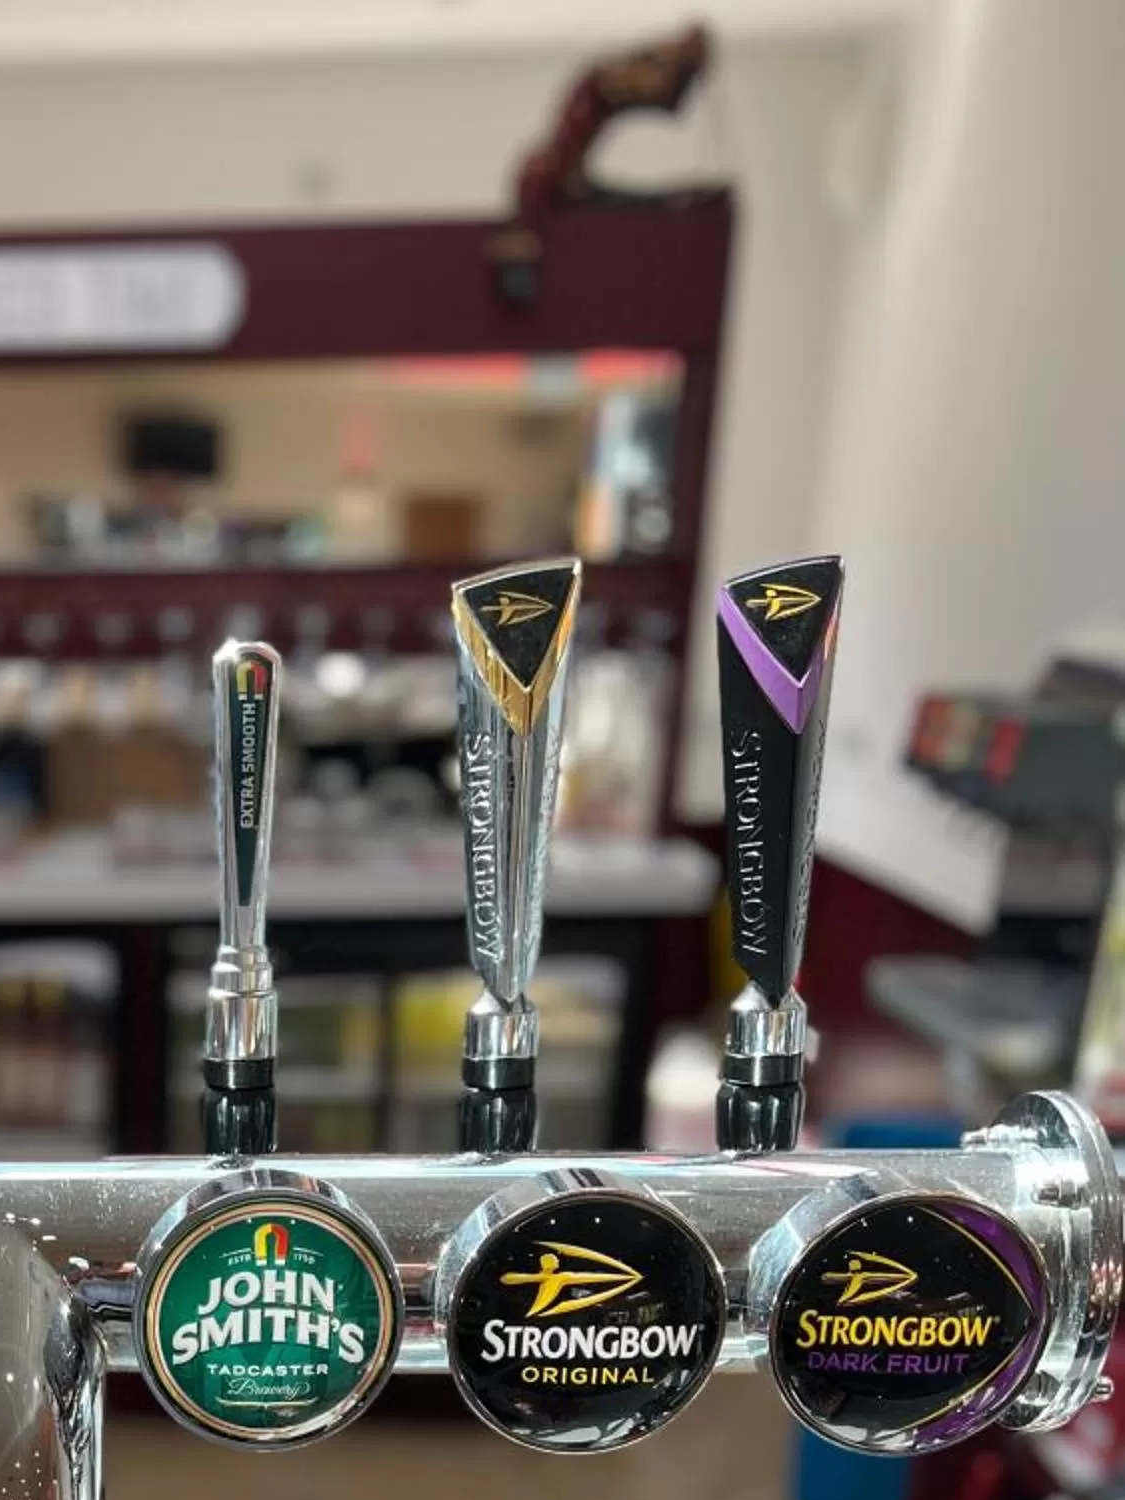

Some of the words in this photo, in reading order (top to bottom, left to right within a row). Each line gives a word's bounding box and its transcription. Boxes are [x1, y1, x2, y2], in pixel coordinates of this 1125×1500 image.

[241, 703, 256, 773] SMOOTH
[240, 778, 256, 829] EXTRA
[463, 732, 505, 965] STRONGBOW
[730, 727, 768, 955] STRONGBOW
[197, 1269, 334, 1314] JOHN
[172, 1308, 364, 1365] SMITH'S
[481, 1319, 698, 1362] STRONGBOW
[796, 1309, 993, 1348] STRONGBOW
[206, 1363, 328, 1376] TADCASTER
[521, 1367, 654, 1384] ORIGINAL
[808, 1351, 878, 1372] DARK
[887, 1353, 969, 1374] FRUIT
